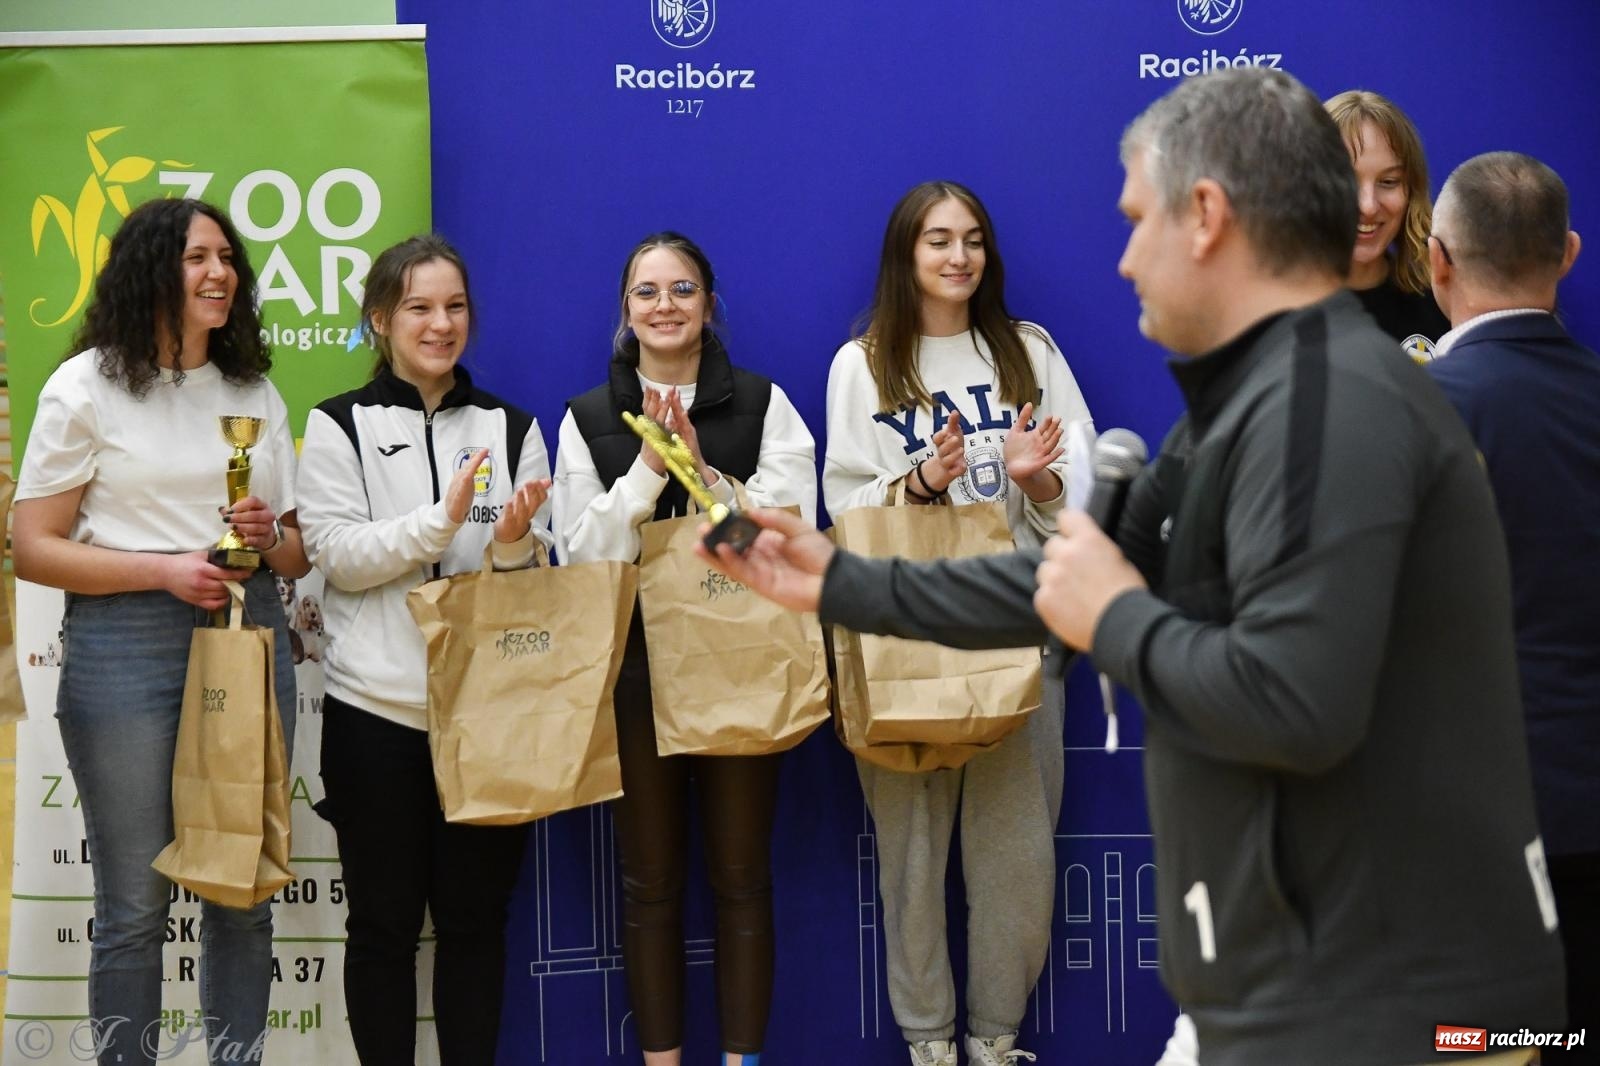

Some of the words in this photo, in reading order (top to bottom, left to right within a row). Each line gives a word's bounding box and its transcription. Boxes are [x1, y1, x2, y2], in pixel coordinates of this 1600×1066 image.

[615, 62, 756, 89] Racibórz
[667, 99, 704, 119] 1217
[256, 243, 373, 317] AR
[53, 849, 75, 864] UL.
[57, 928, 80, 943] UL.
[295, 957, 325, 982] 37
